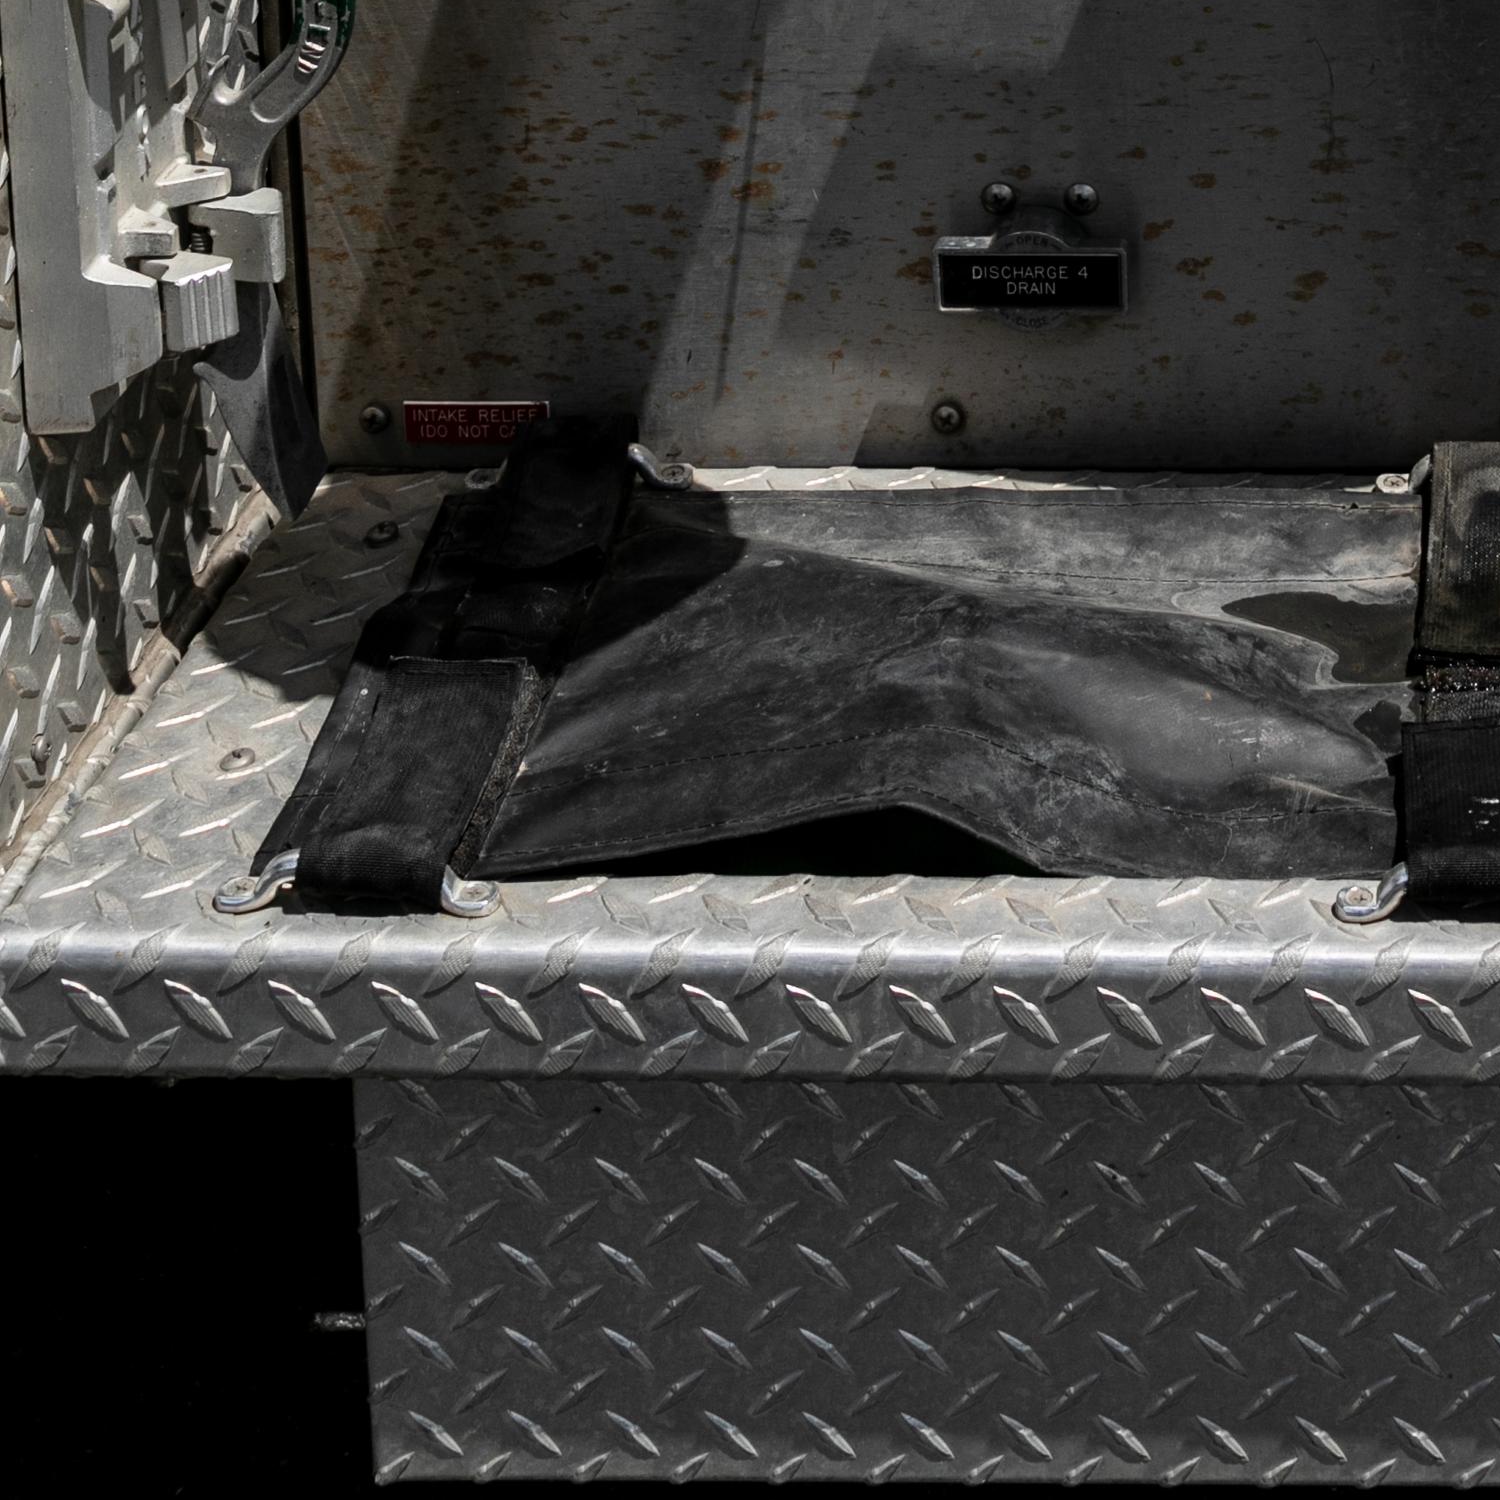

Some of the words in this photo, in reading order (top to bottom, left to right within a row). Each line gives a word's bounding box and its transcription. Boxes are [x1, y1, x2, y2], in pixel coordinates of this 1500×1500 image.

[1015, 235, 1049, 247] OPEN
[972, 266, 1069, 280] DISCHARGE
[1077, 266, 1089, 279] 4
[1006, 281, 1056, 295] DRAIN
[412, 408, 468, 423] INTAKE
[478, 408, 538, 423] RELIEF
[458, 424, 490, 438] NOT
